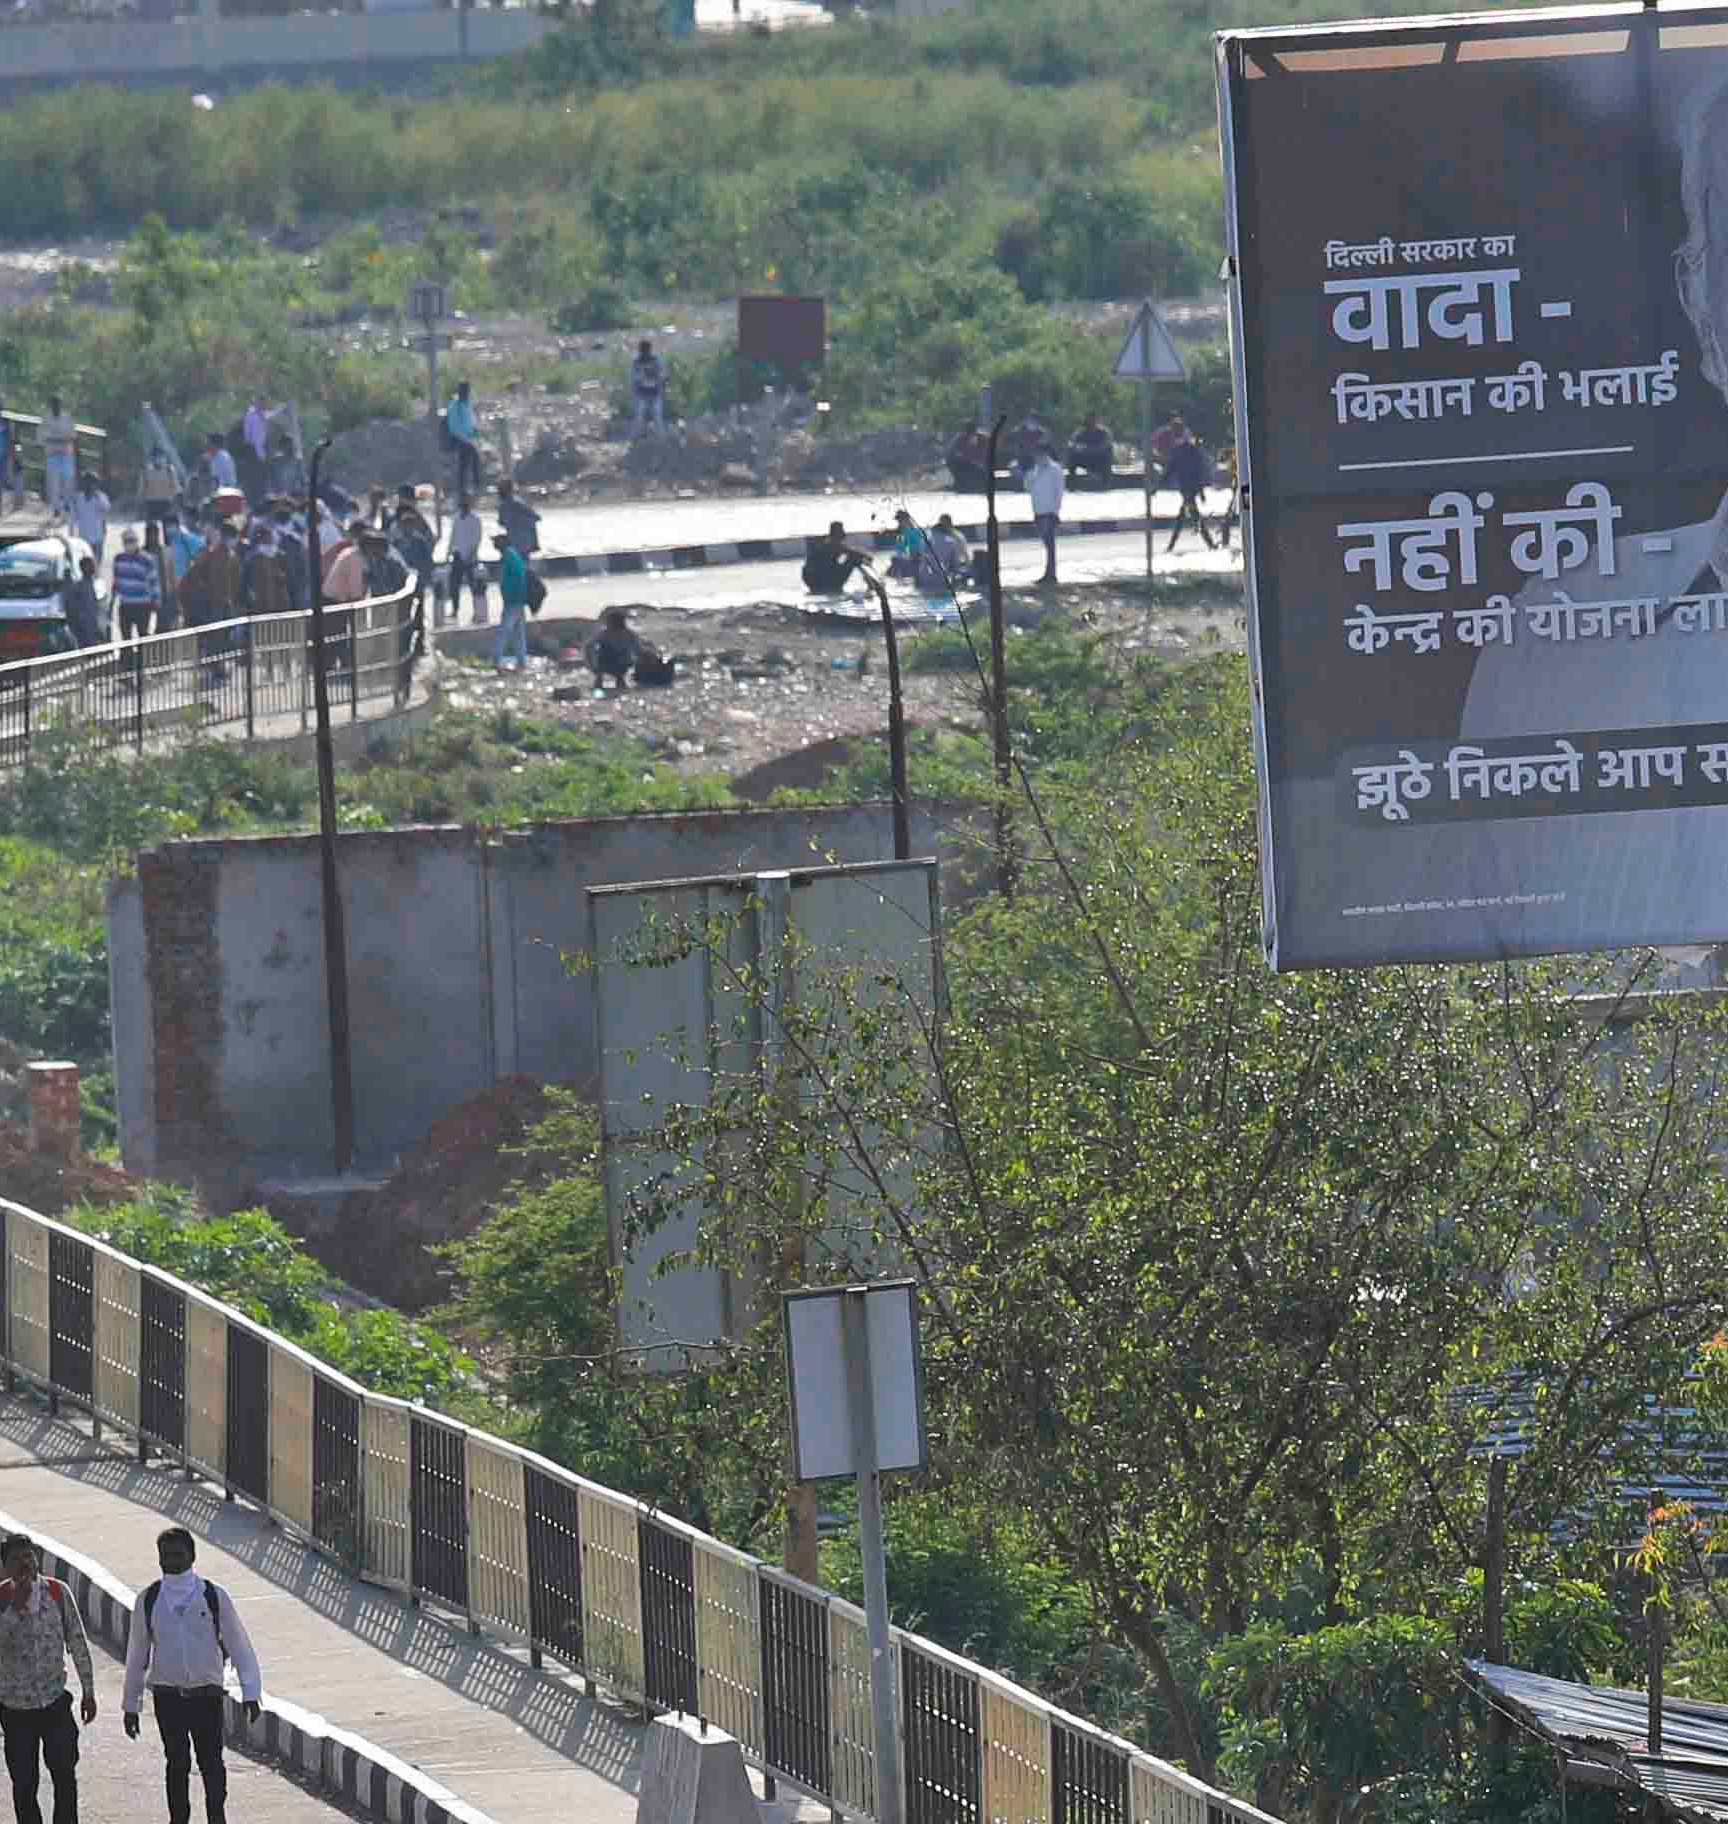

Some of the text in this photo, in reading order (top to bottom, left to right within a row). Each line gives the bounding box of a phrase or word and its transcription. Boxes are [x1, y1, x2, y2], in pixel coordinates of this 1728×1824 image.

[1324, 234, 1516, 267] दिल्ली सरकार का
[1324, 269, 1521, 351] वादा
[1330, 349, 1680, 424] किसान की भलाई
[1336, 491, 1495, 592] नहीं
[1502, 481, 1626, 586] की
[1342, 603, 1444, 654] केन्द्र
[1454, 595, 1517, 647] की
[1526, 591, 1657, 643] योजना
[1351, 750, 1434, 821] झूठे
[1446, 739, 1584, 801] निकले
[1597, 746, 1685, 789] आप
